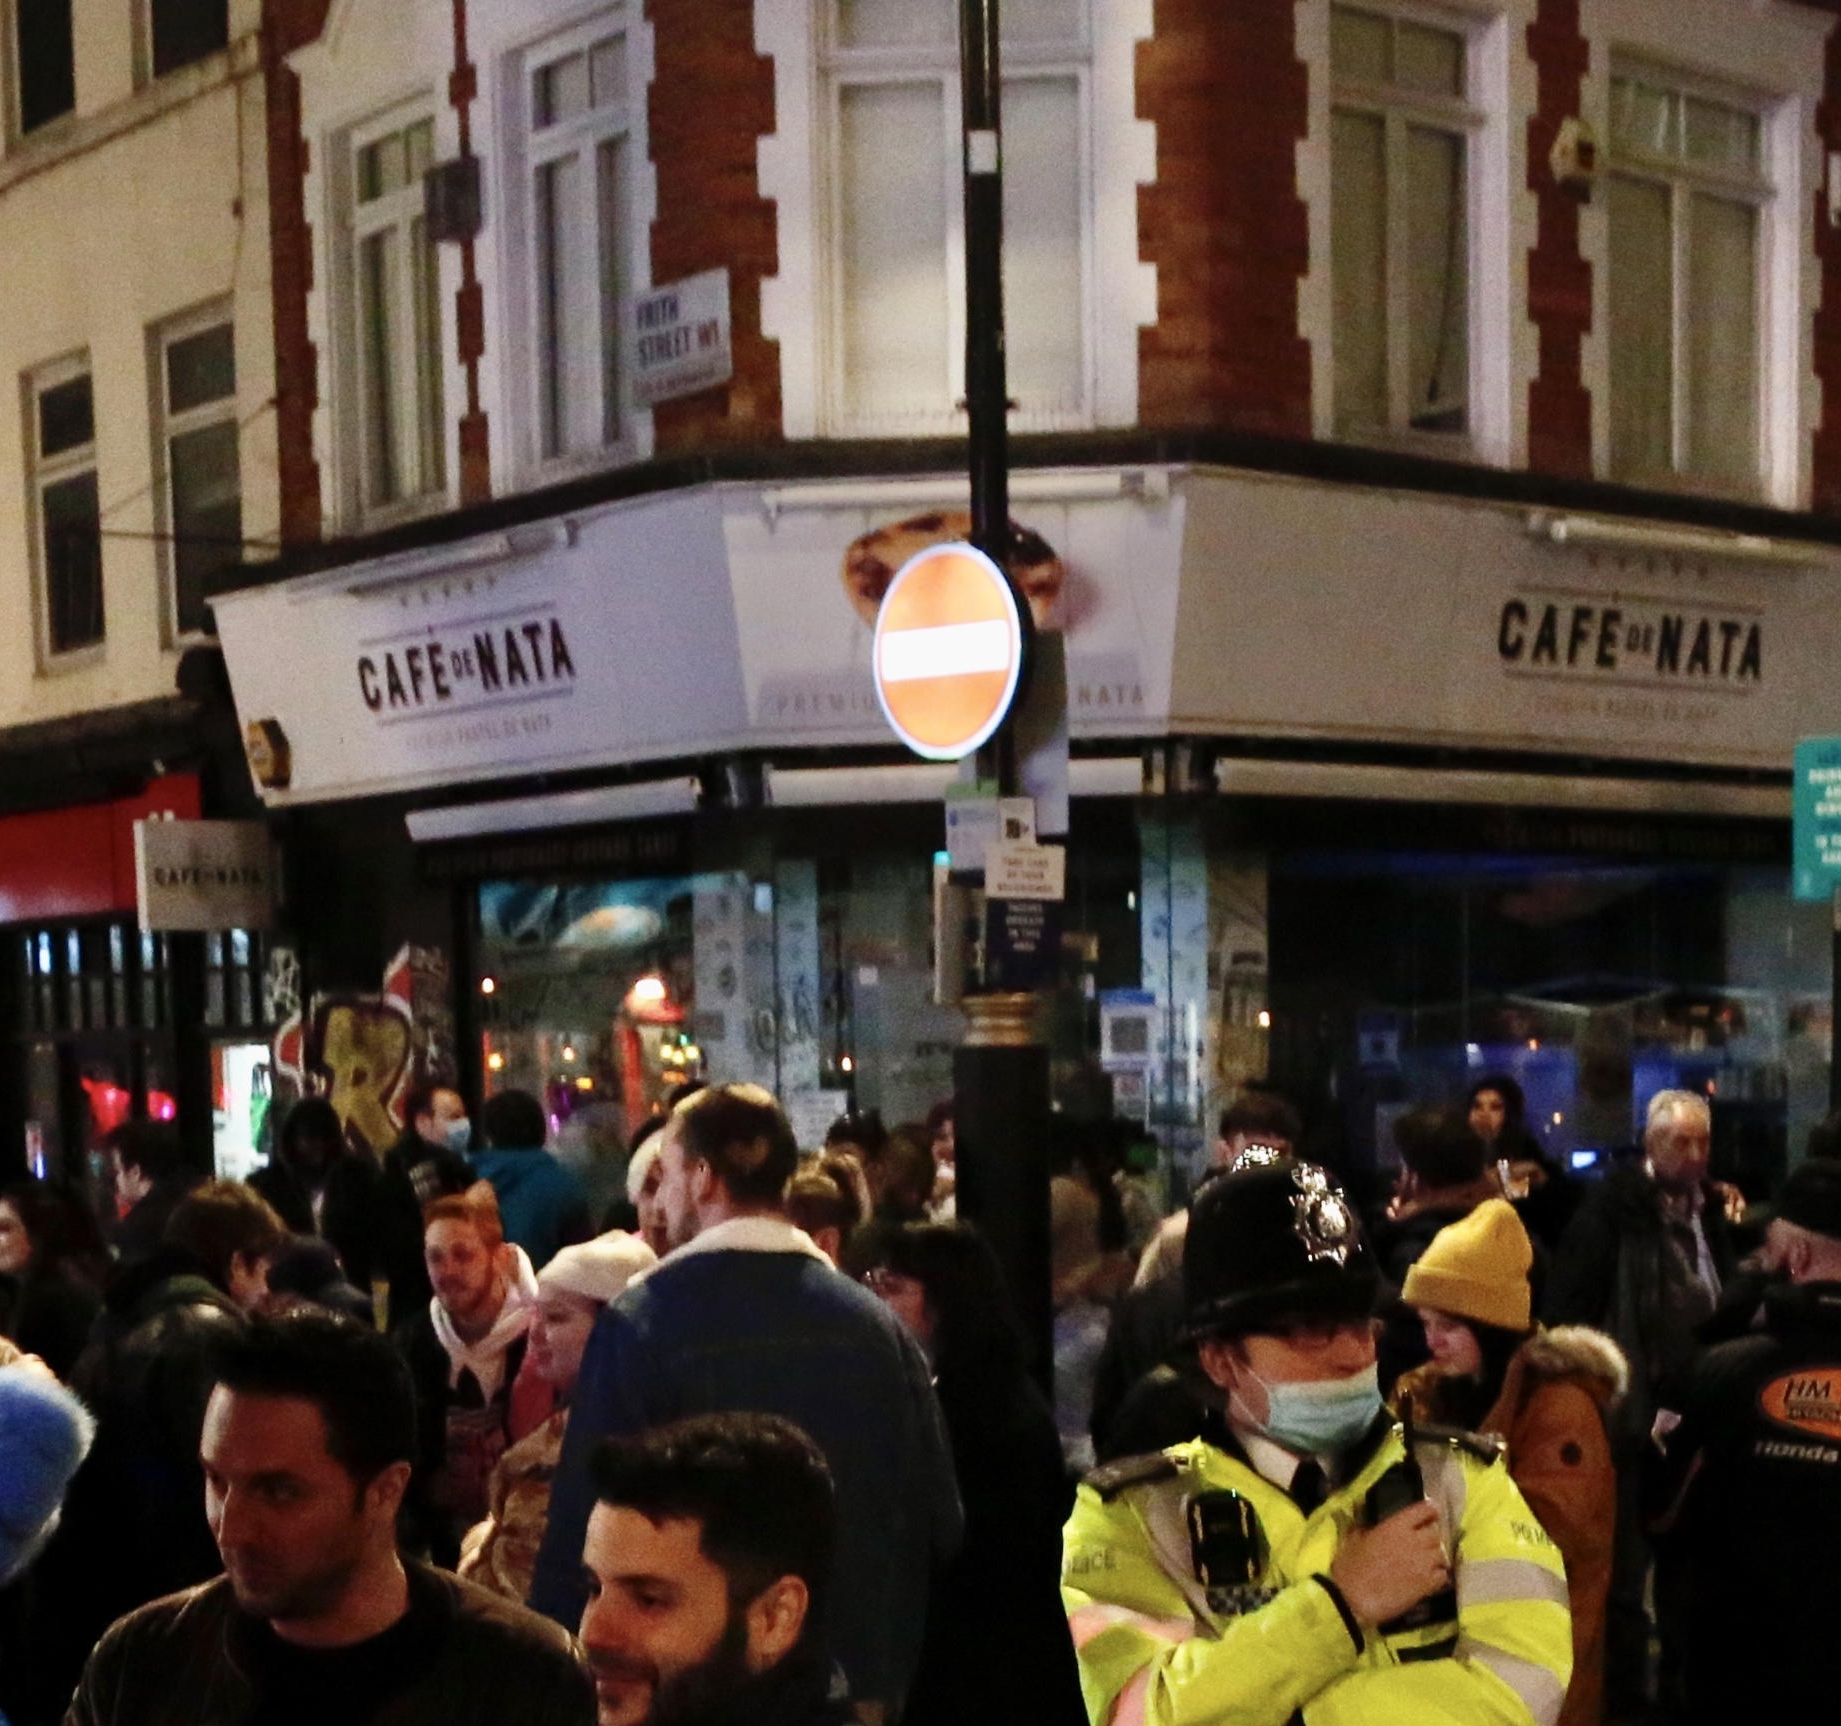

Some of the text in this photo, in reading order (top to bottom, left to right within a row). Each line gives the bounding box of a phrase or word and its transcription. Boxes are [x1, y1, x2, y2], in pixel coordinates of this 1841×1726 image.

[638, 297, 679, 328] FRITH
[639, 327, 690, 368] STREET
[474, 617, 576, 691] NATA
[1657, 613, 1762, 678] NATA
[775, 682, 1144, 718] PREMIU NATA
[1783, 1377, 1831, 1403] HM
[1756, 1440, 1839, 1464] Honda
